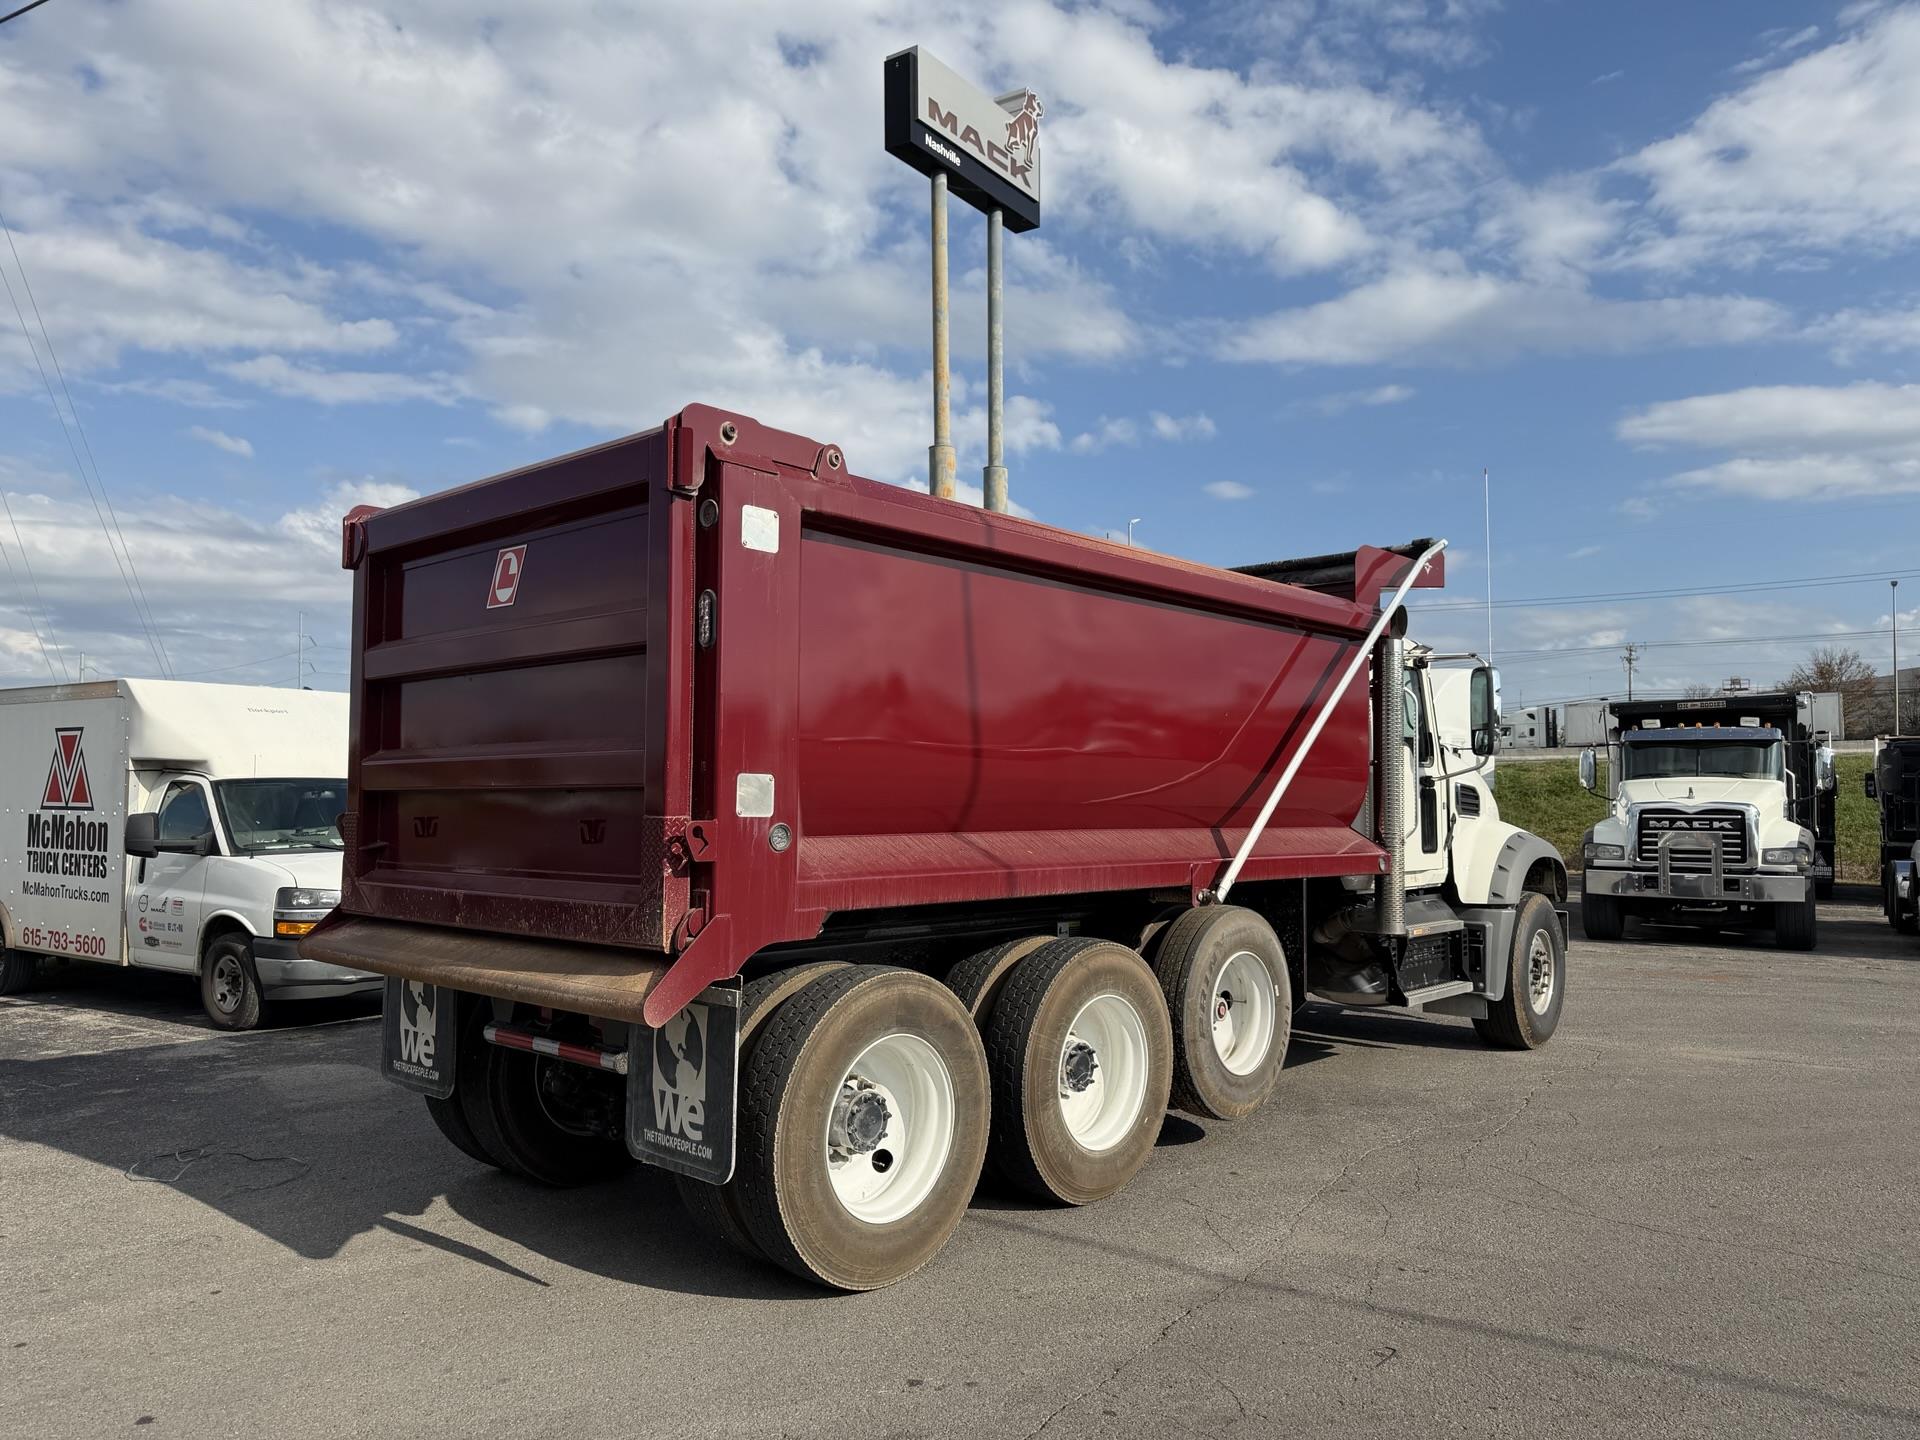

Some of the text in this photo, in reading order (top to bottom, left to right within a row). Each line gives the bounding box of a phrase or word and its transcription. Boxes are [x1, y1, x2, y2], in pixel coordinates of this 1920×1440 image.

[925, 132, 961, 167] Nashville
[928, 96, 1033, 190] MACK
[27, 813, 109, 853] McMahon
[1649, 820, 1734, 829] MACK
[27, 851, 107, 879] TRUCK CENTERS
[22, 880, 110, 903] McMahonTrucks.com
[22, 927, 106, 956] 615-793-5600
[400, 1028, 435, 1068] We
[653, 1086, 705, 1141] We
[643, 1128, 713, 1160] THETRUCKPEOPLE.COM
